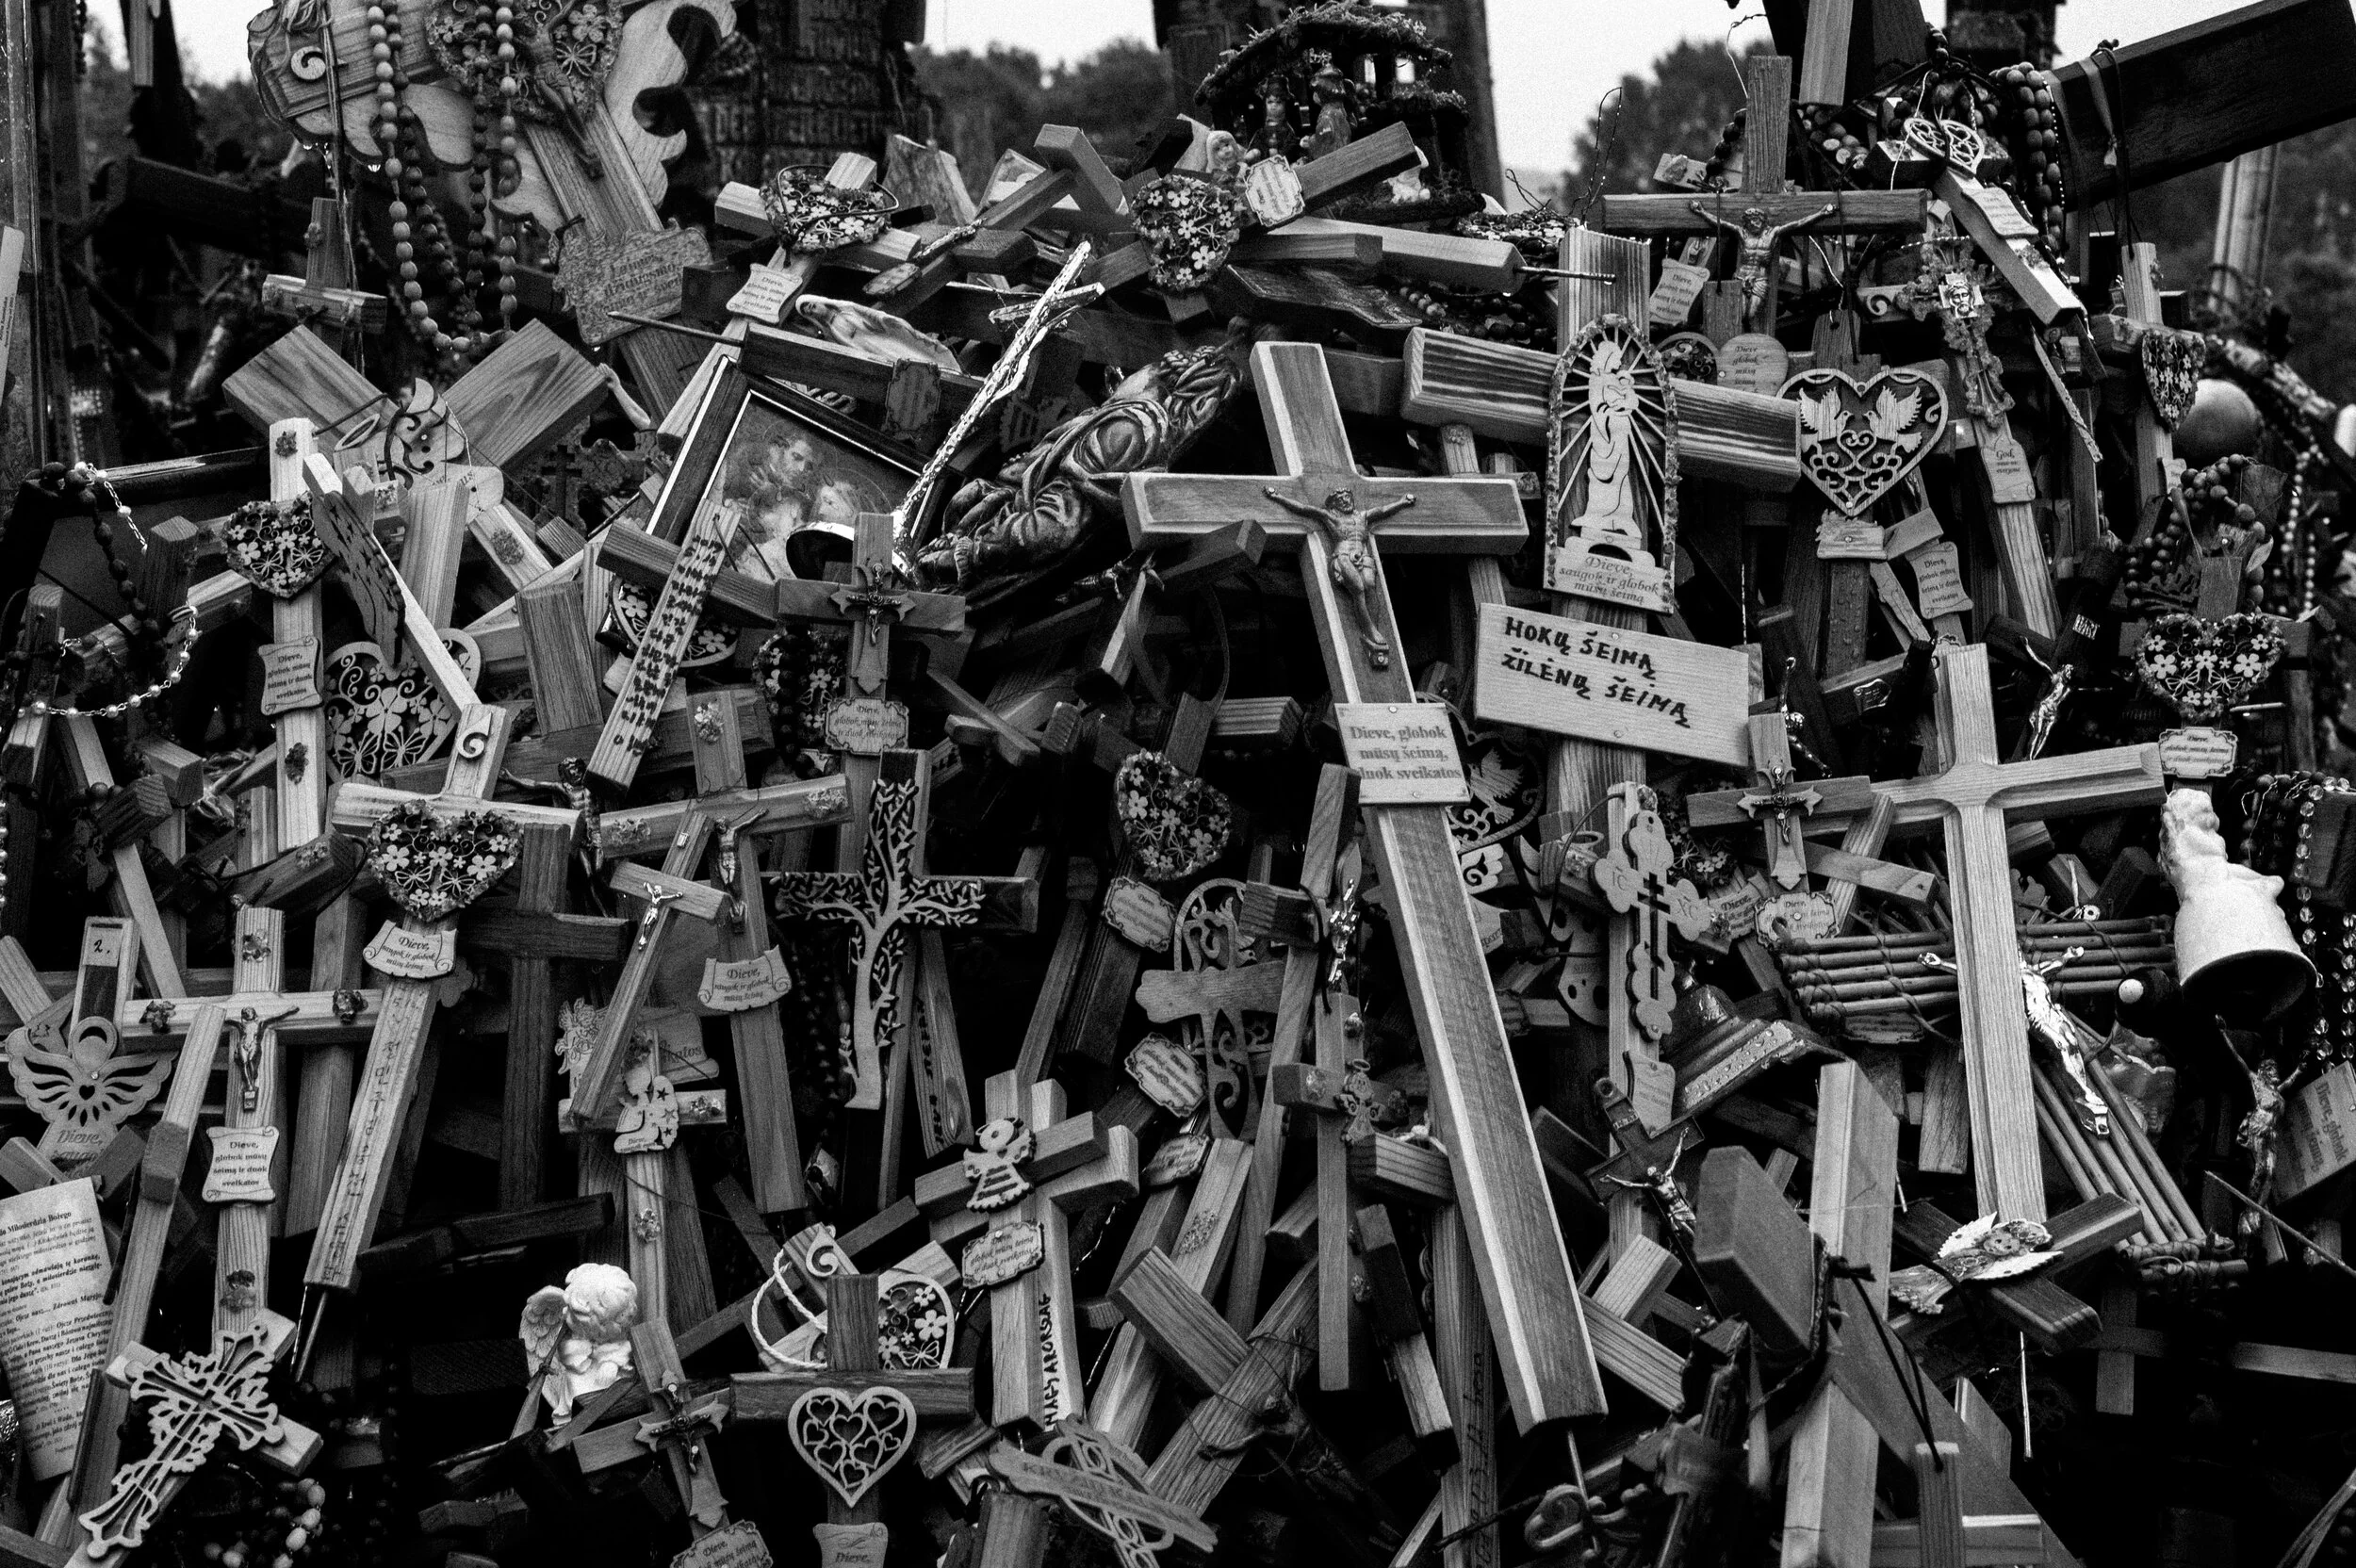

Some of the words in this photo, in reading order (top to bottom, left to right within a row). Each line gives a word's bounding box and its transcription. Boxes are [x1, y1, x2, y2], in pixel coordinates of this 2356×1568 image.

[1996, 449, 2016, 460] God,
[1584, 556, 1634, 578] Dieve,
[1558, 567, 1604, 585] saugok
[1606, 574, 1616, 585] ir
[1616, 577, 1661, 596] globok
[277, 653, 303, 663] Dieve,
[1349, 726, 1396, 742] Dieve,
[1398, 726, 1448, 743] globok
[1359, 747, 1402, 763] mūsų
[1402, 745, 1449, 762] šeimą,
[1396, 766, 1462, 780] sveikatos
[93, 939, 111, 954] 2.
[399, 936, 431, 952] Dieve,
[727, 967, 761, 981] Dieve,
[57, 1129, 105, 1146] Dieve,
[229, 1141, 259, 1151] Dieve,
